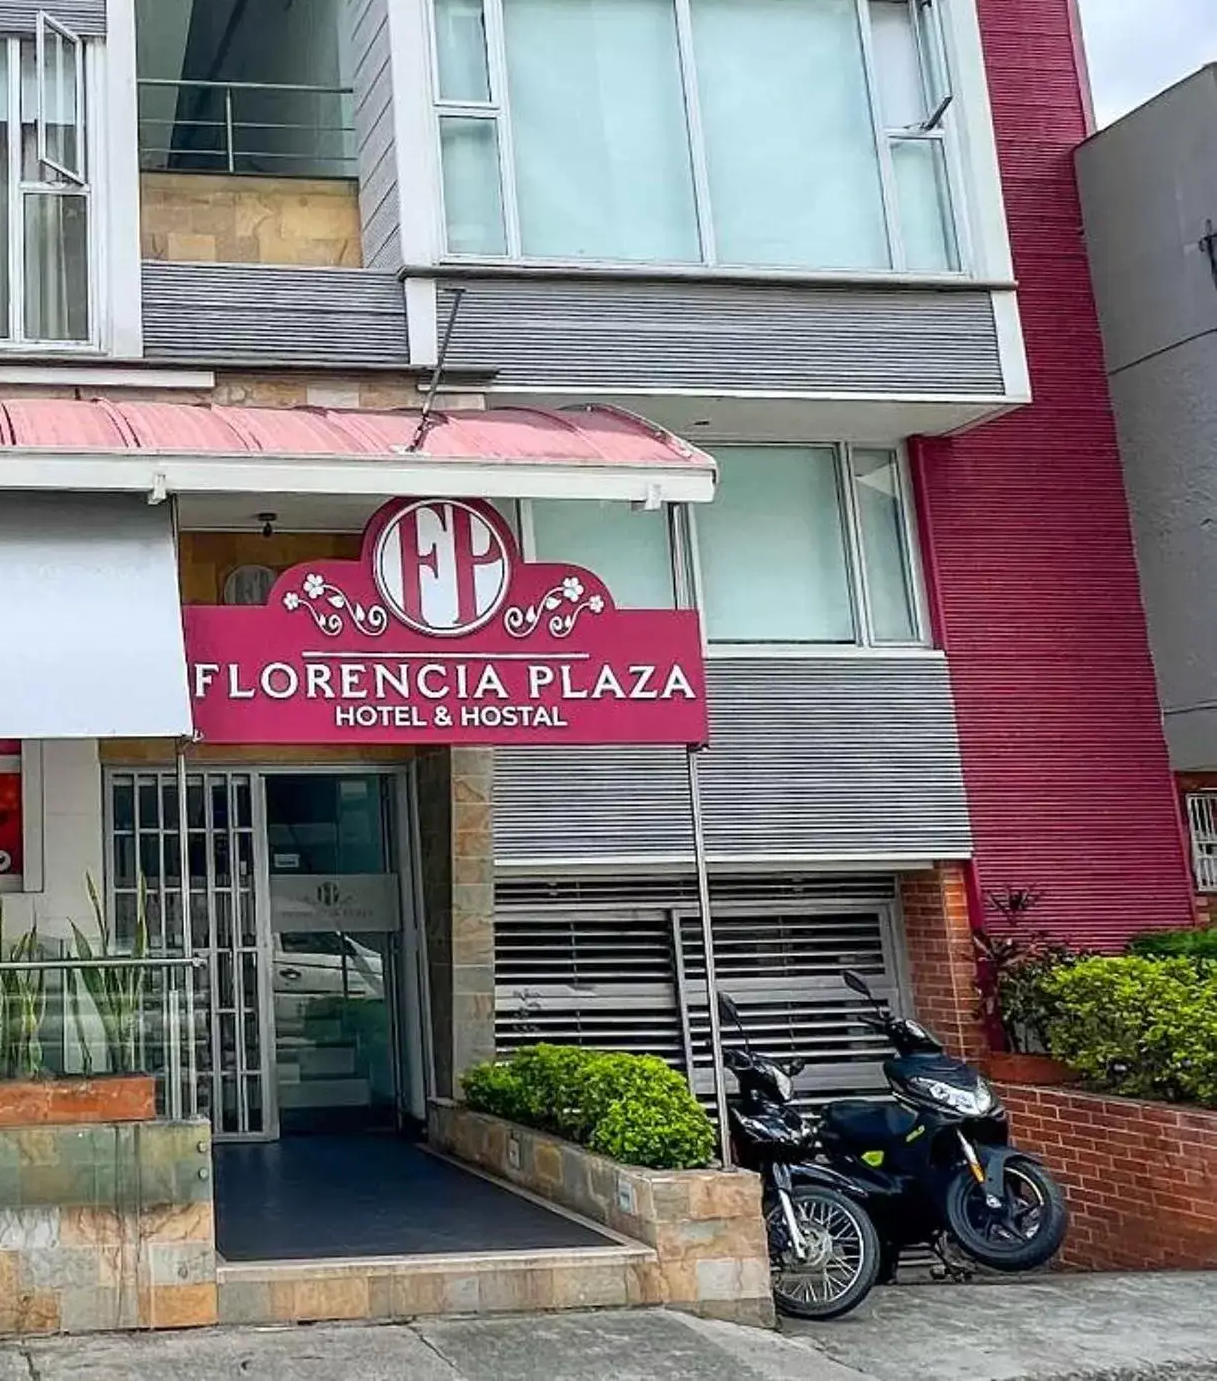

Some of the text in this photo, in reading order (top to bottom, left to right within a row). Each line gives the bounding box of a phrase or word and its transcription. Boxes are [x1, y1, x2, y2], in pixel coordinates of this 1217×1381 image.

[194, 663, 696, 700] FLORENCIA PLAZA
[336, 706, 568, 727] HOTEL & HOSTAL
